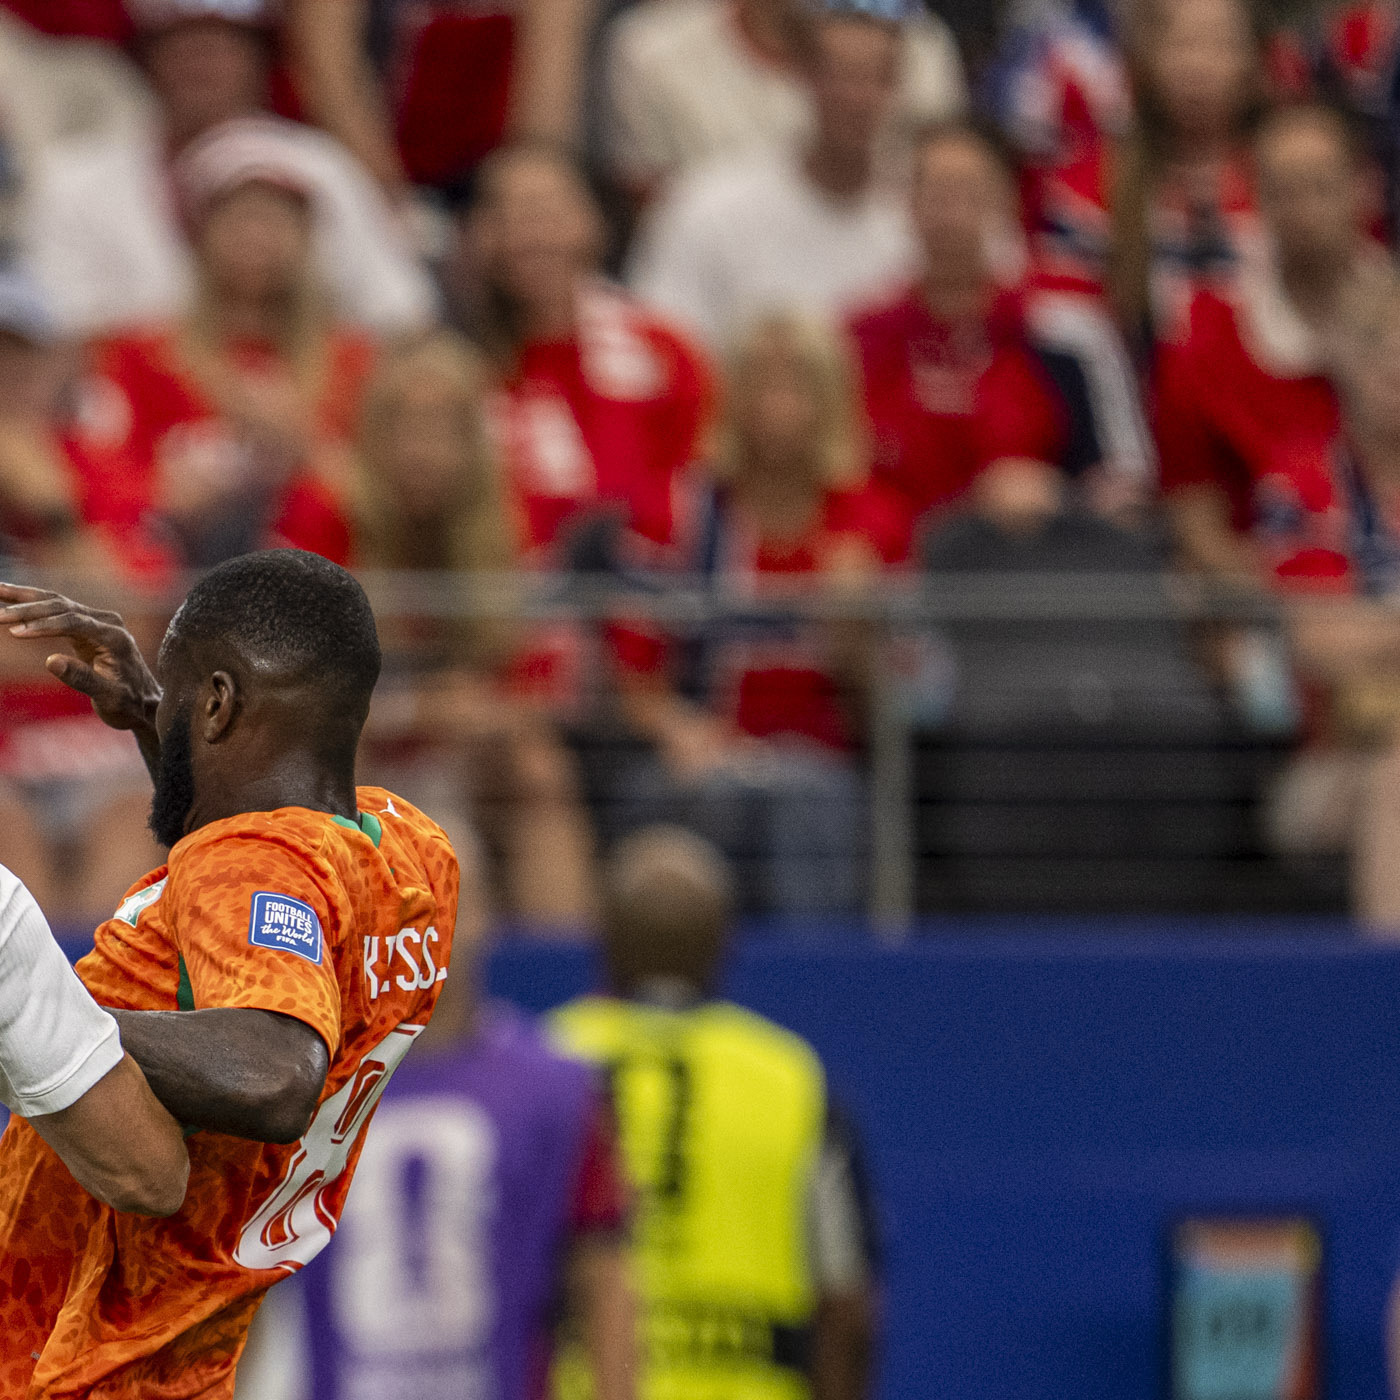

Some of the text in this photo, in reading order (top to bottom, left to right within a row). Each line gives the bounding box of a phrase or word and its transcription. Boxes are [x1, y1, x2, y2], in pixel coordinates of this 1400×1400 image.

[265, 901, 312, 924] FOOTBALL
[265, 911, 312, 934] UNITES
[260, 924, 314, 946] the World
[276, 935, 297, 946] FIFA
[232, 1023, 427, 1274] 8
